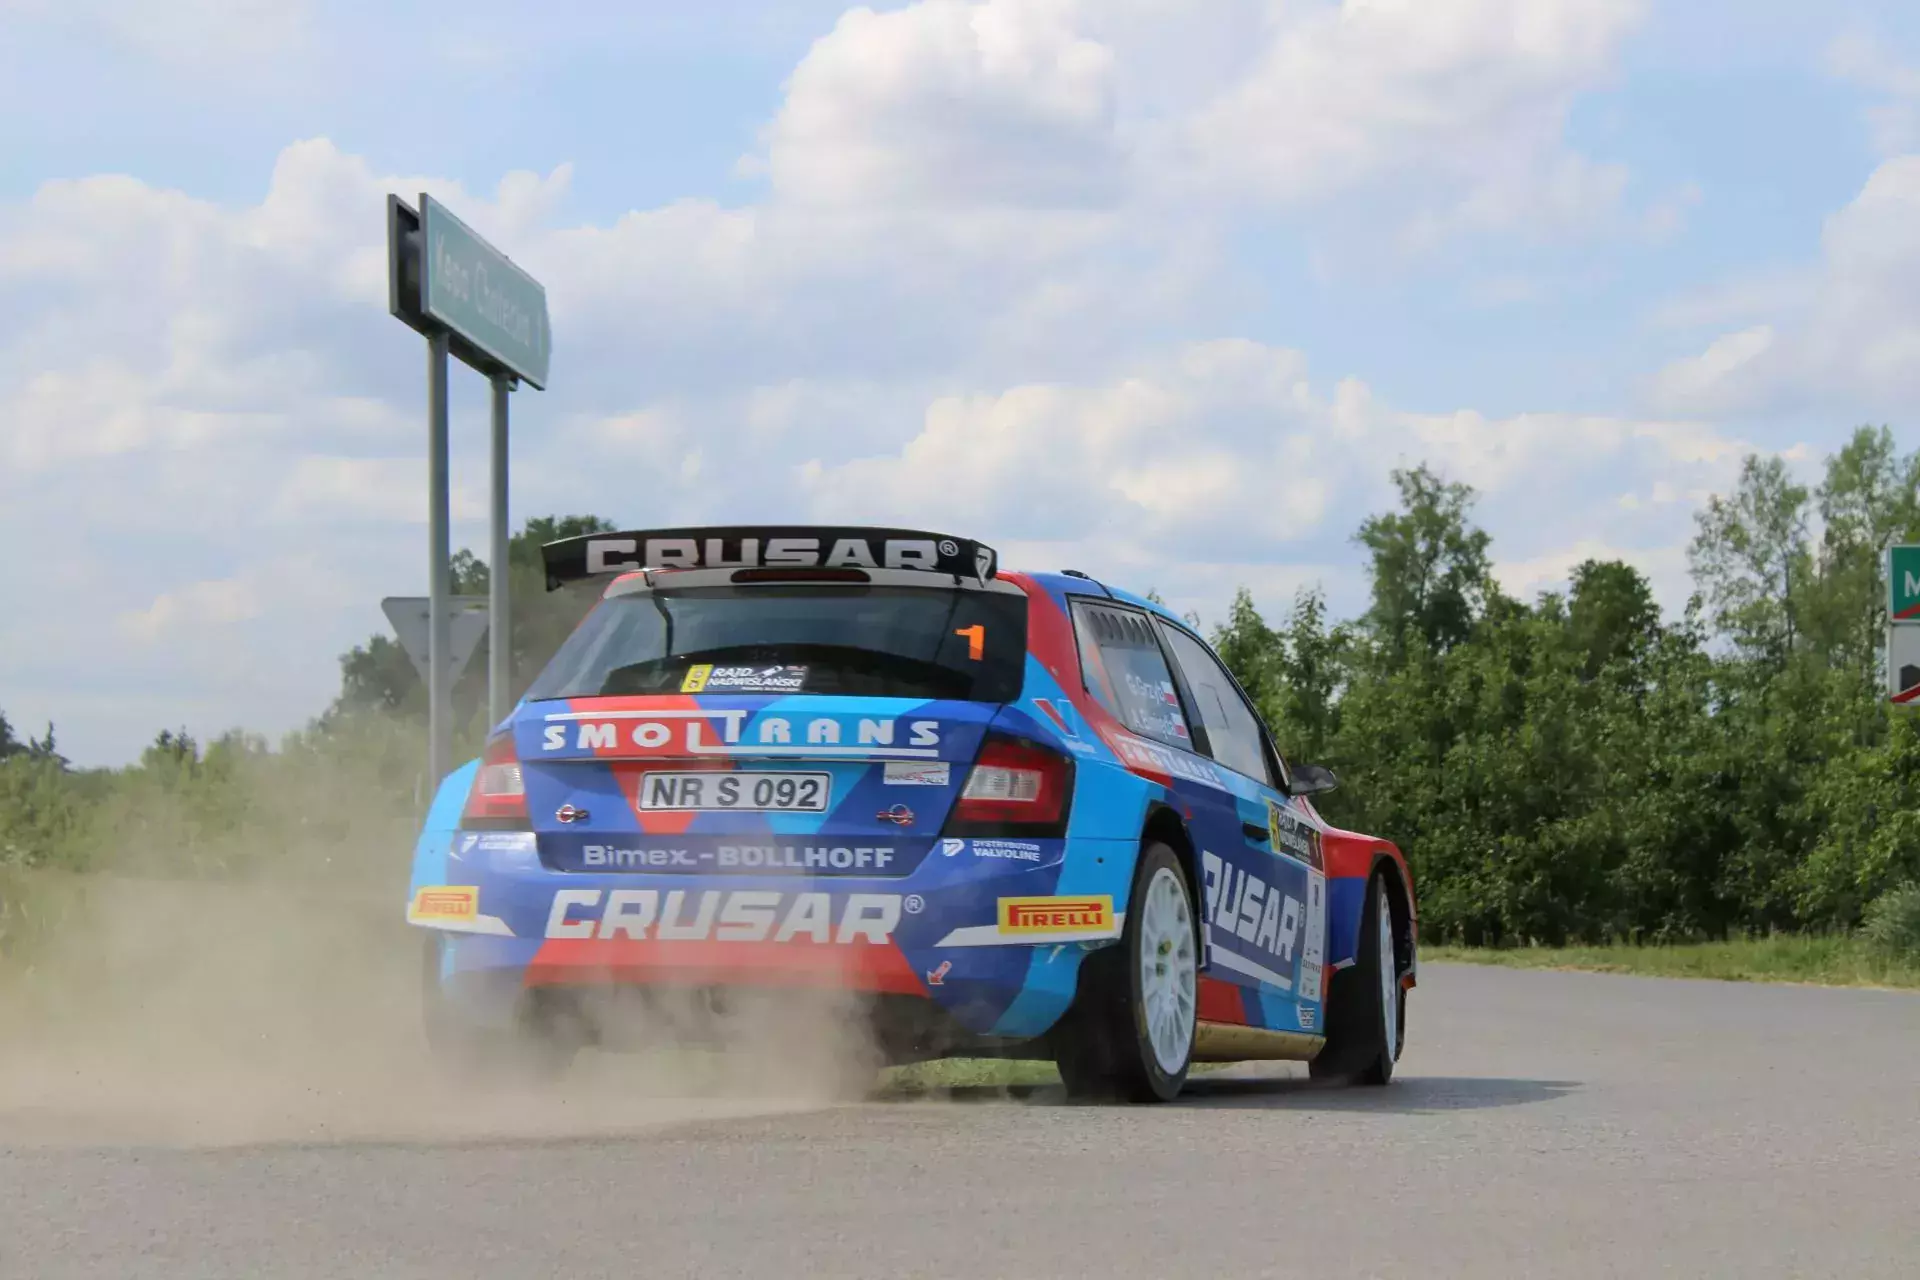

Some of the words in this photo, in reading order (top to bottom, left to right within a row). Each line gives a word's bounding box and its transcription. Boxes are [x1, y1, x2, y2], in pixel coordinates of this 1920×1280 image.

[954, 624, 986, 661] 1
[542, 710, 940, 758] SMOLTRANS
[650, 777, 706, 807] NR
[717, 776, 740, 807] S
[752, 777, 818, 808] 092
[973, 847, 1041, 862] VALVOLINE
[1007, 903, 1103, 927] PIRELLI
